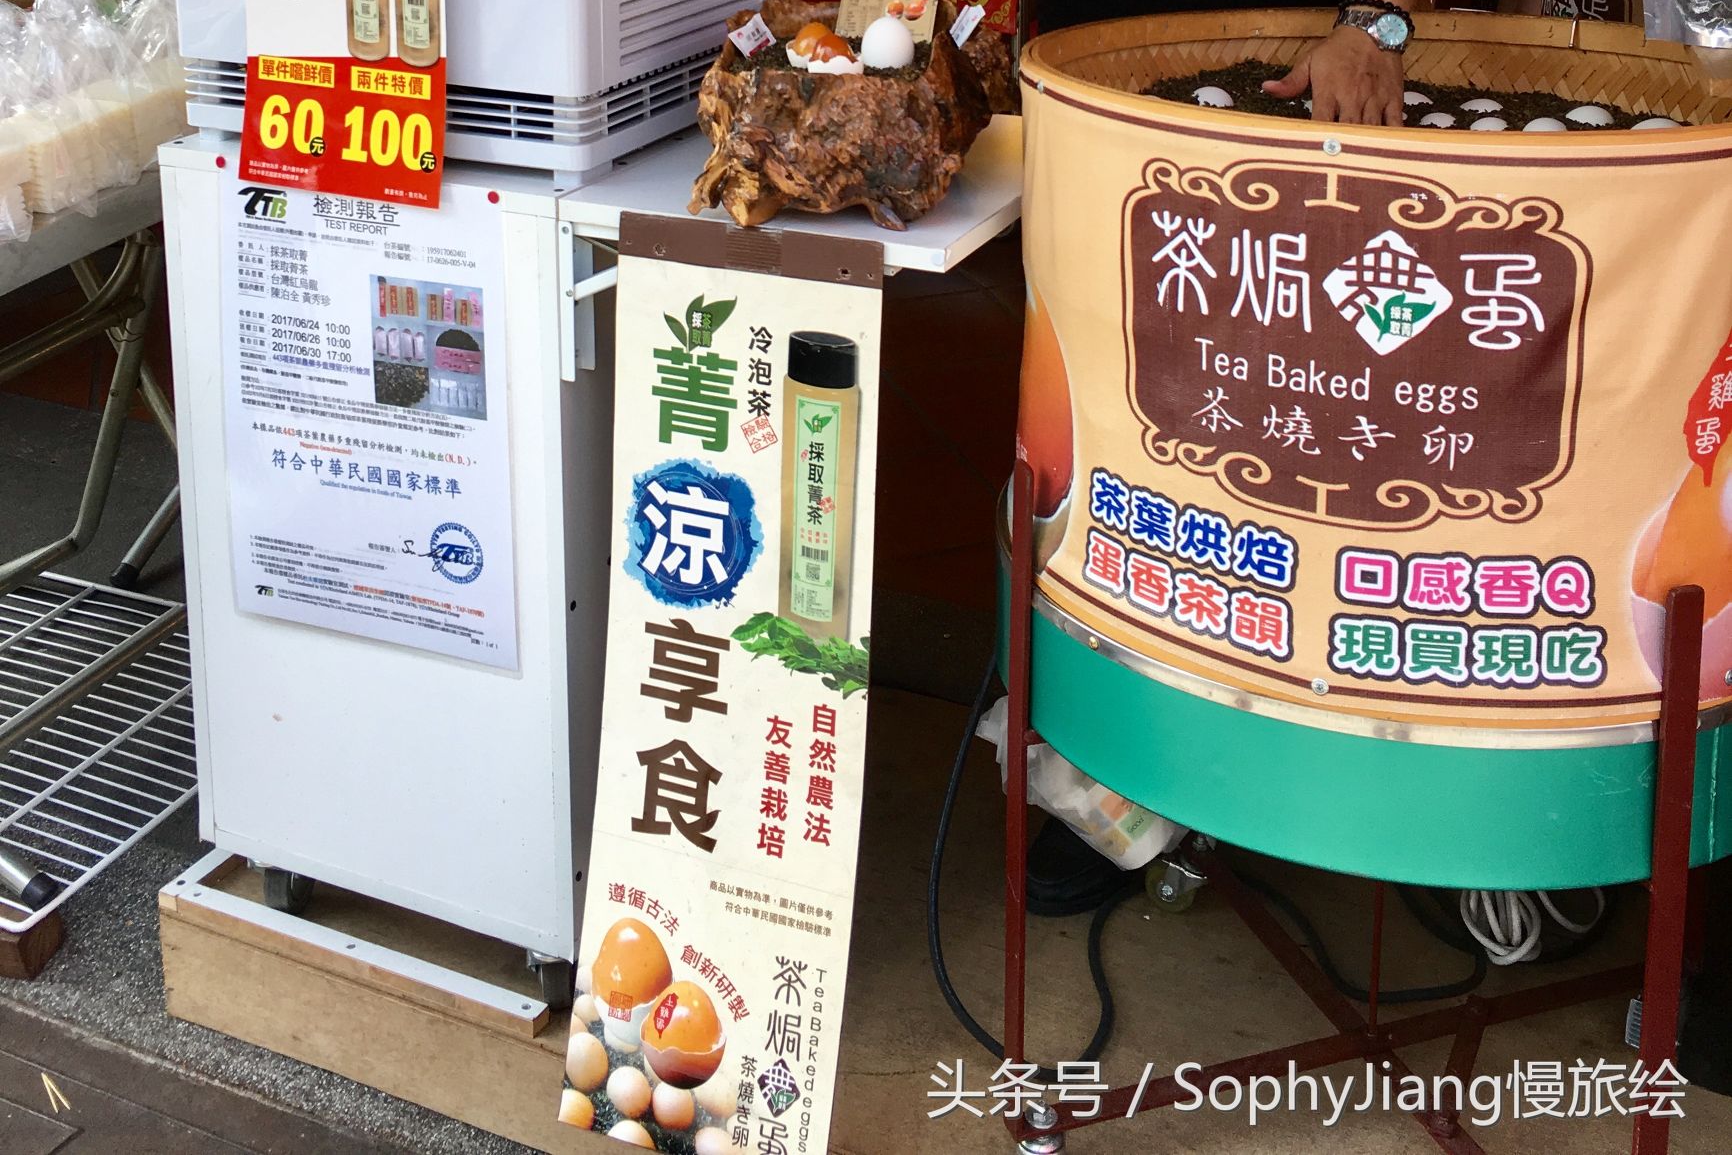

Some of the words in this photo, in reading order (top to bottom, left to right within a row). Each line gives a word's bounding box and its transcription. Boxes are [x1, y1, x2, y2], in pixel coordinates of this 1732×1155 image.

[357, 70, 424, 95] 兩件特價
[313, 194, 399, 223] 檢測報告
[325, 219, 347, 231] TEST
[350, 223, 388, 236] REPORT
[271, 313, 320, 331] 2017/06/24
[326, 322, 351, 335] 10:00
[271, 327, 320, 345] 2017/06/26
[326, 336, 351, 349] 10:00
[272, 341, 321, 359] 2017/06/30
[327, 350, 352, 363] 17:00
[748, 326, 774, 417] 冷泡茶
[1194, 337, 1249, 383] Tea
[1267, 354, 1371, 402] Baked
[1394, 379, 1480, 415] eggs
[1191, 387, 1475, 472] 茶燒き卵
[271, 448, 462, 500] 符合中華民國國家標準
[807, 441, 825, 526] 採取菁茶
[1091, 471, 1294, 589] 茶葉烘焙
[1086, 533, 1290, 657] 蛋香茶韻
[1340, 551, 1594, 614] 口感香Q
[1334, 618, 1604, 684] 現買現吃
[756, 715, 793, 859] 友善栽培
[803, 703, 837, 847] 自然農法
[608, 882, 680, 937] 遵循古法
[680, 944, 751, 1023] 創新研製
